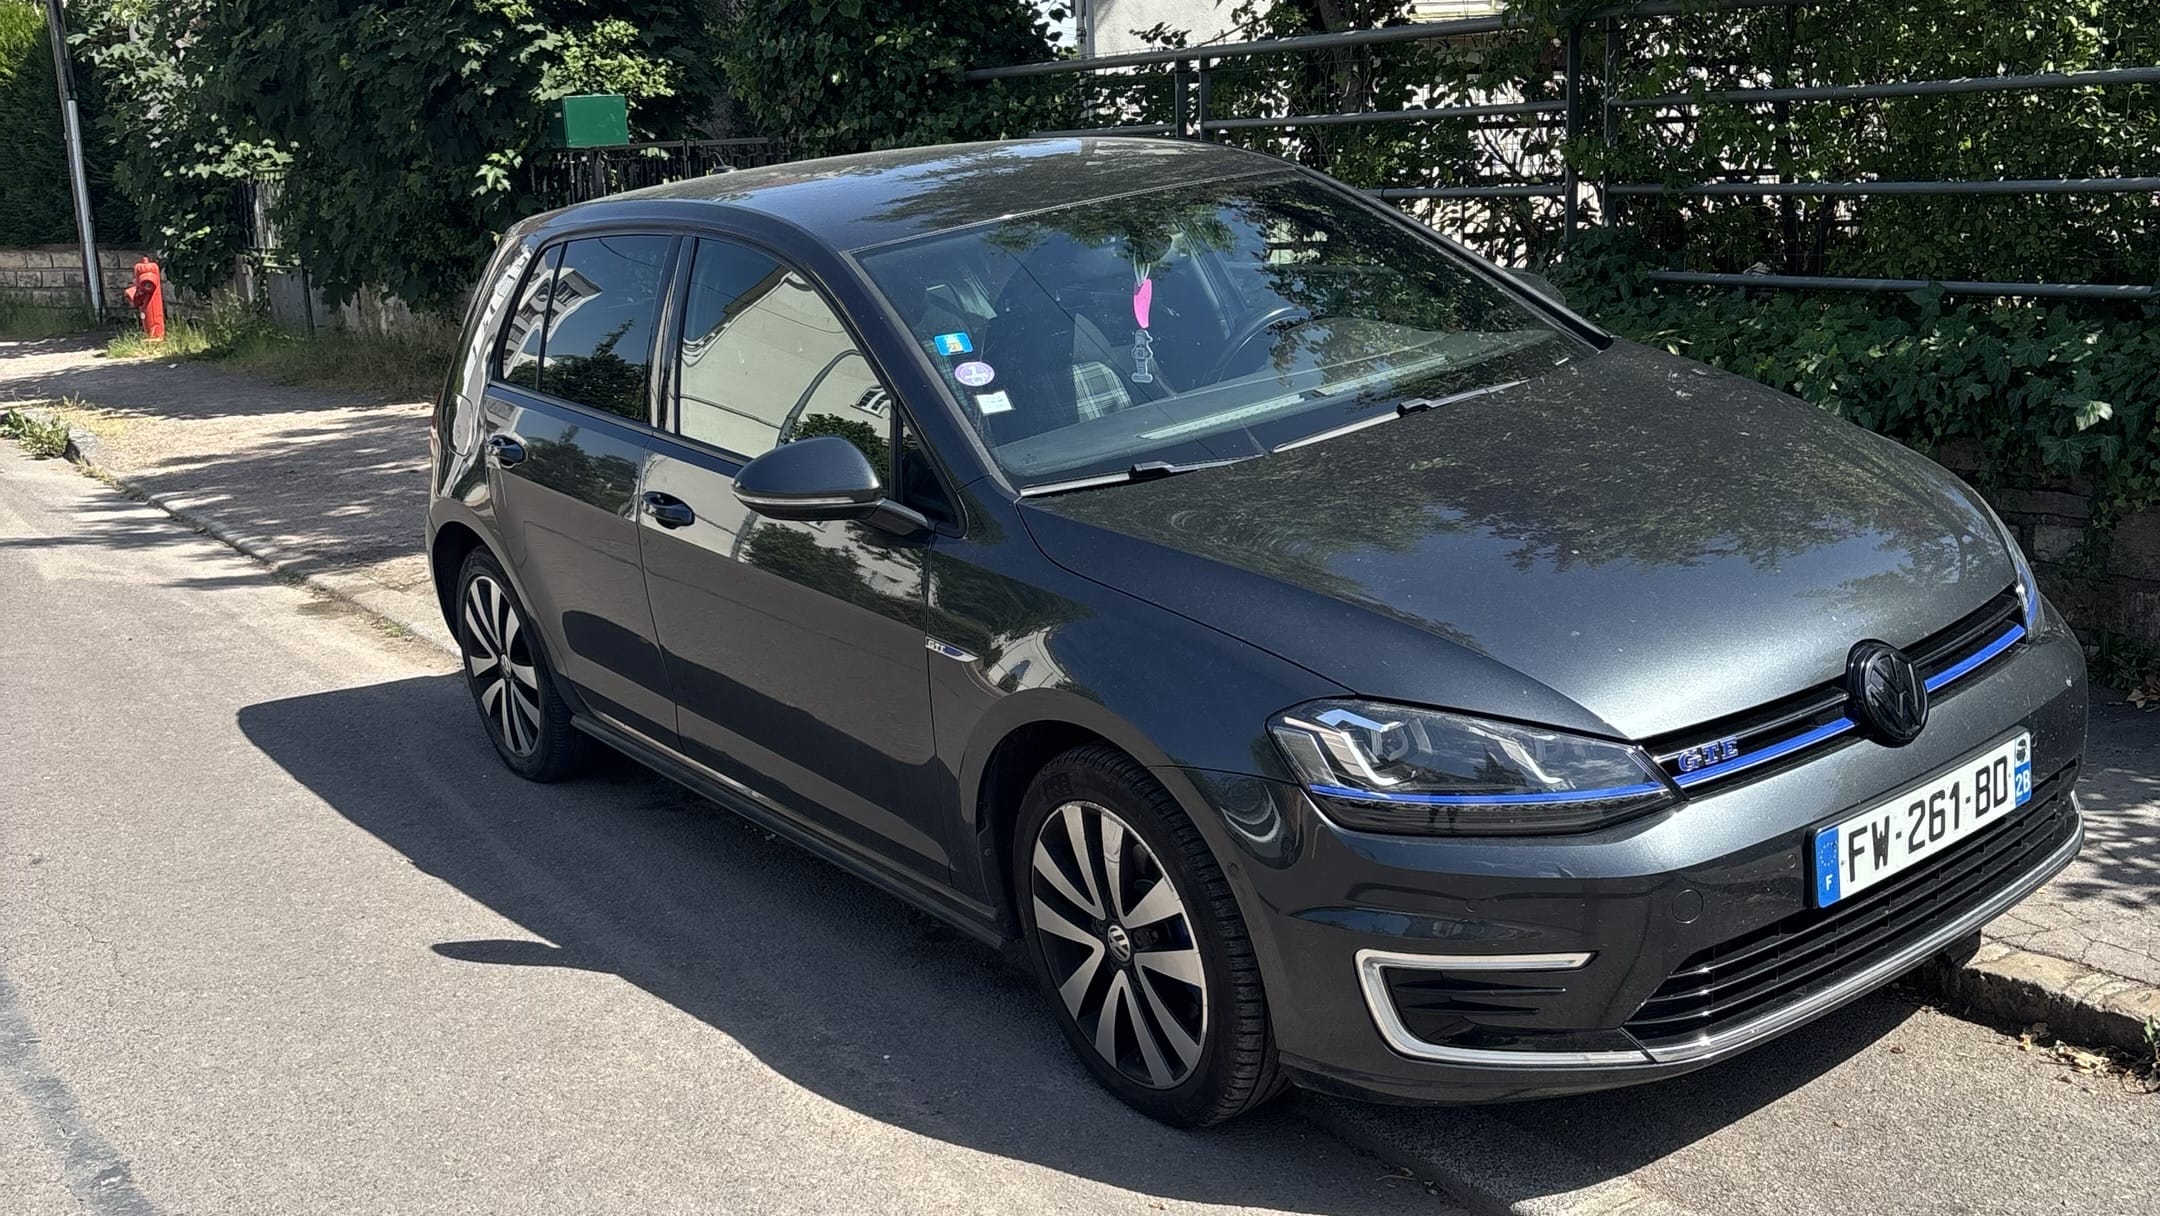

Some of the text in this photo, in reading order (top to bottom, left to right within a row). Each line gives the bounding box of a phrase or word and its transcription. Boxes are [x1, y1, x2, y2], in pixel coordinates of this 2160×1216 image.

[1678, 736, 1739, 772] GTE
[2015, 769, 2031, 798] 2B
[1848, 755, 2008, 883] FW-261-BD
[1825, 874, 1833, 891] F
